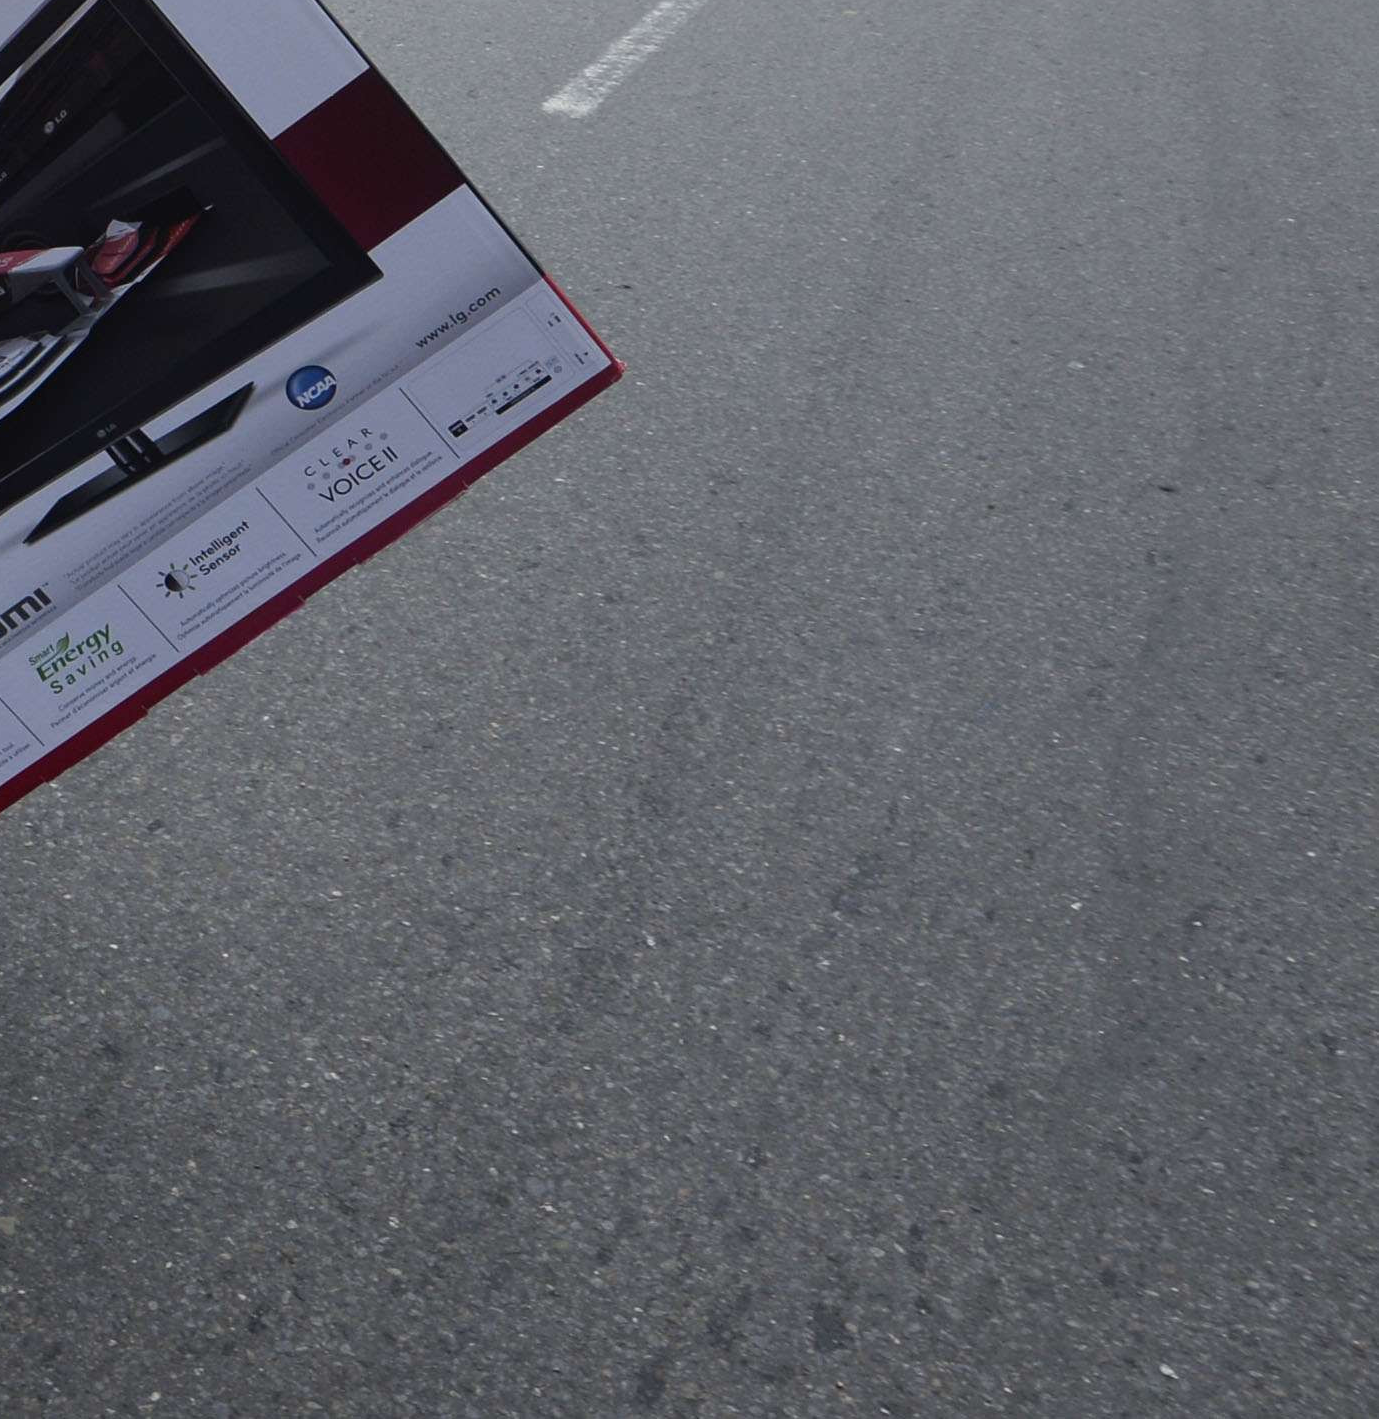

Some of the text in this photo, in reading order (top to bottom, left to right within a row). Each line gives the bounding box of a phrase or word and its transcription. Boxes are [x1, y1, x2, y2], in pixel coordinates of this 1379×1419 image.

[414, 284, 502, 351] www.lg.com
[296, 374, 337, 409] NCAA
[303, 427, 375, 478] CLEAR
[318, 454, 387, 505] VOICE
[188, 519, 251, 567] Intelligent
[198, 542, 242, 577] Sensor
[28, 644, 55, 667] Smart
[35, 622, 111, 683] Energy
[50, 638, 125, 696] Saving
